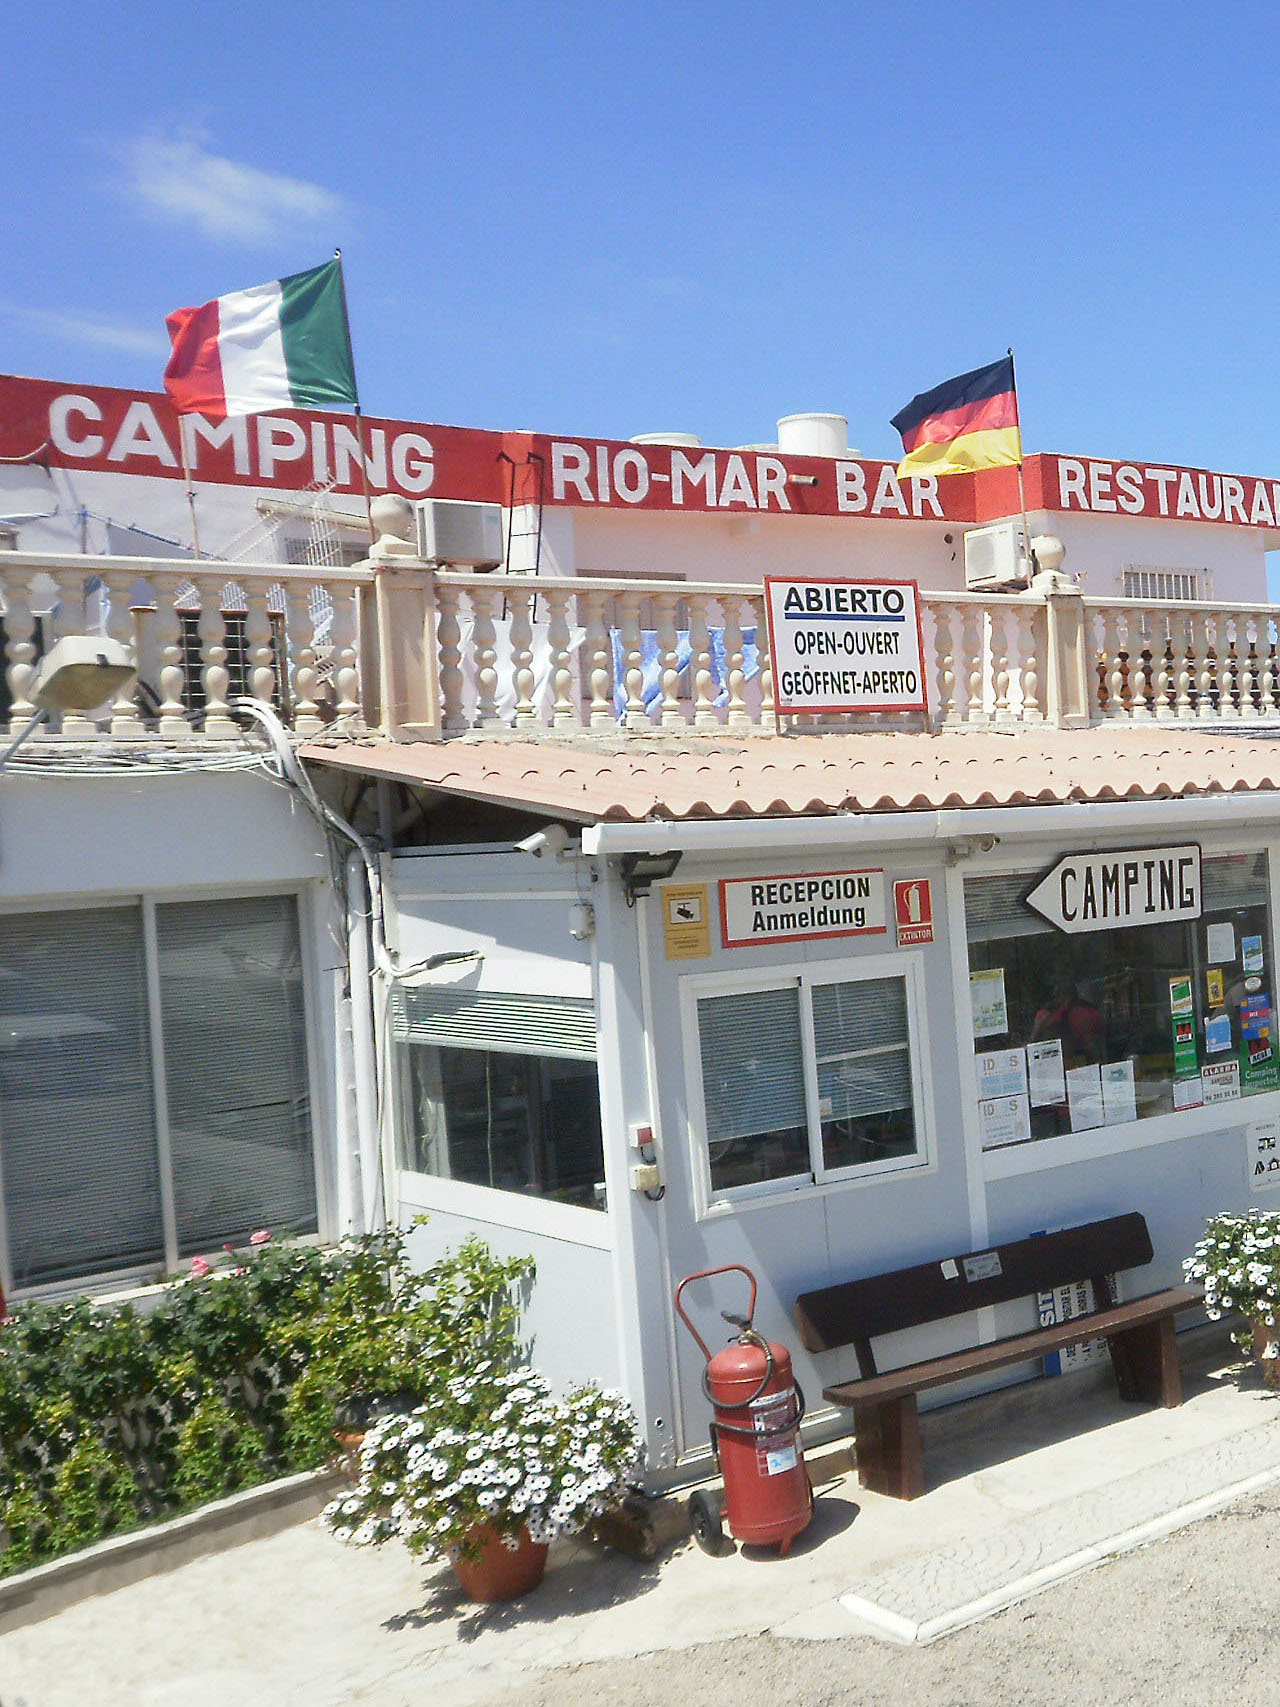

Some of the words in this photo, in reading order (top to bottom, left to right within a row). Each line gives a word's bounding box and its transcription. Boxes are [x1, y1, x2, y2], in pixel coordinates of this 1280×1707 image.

[48, 394, 434, 493] CAMPING
[551, 442, 792, 511] RIO-MAR
[835, 461, 944, 517] BAR
[784, 586, 905, 614] ABIERTO
[794, 631, 900, 655] OPEN-OUVERT
[781, 664, 917, 696] GEÖFFNET-APERTO
[751, 877, 870, 906] RECEPCION
[1060, 857, 1195, 922] CAMPING
[752, 905, 866, 932] Anmeldung
[1204, 1063, 1238, 1077] ALARMA
